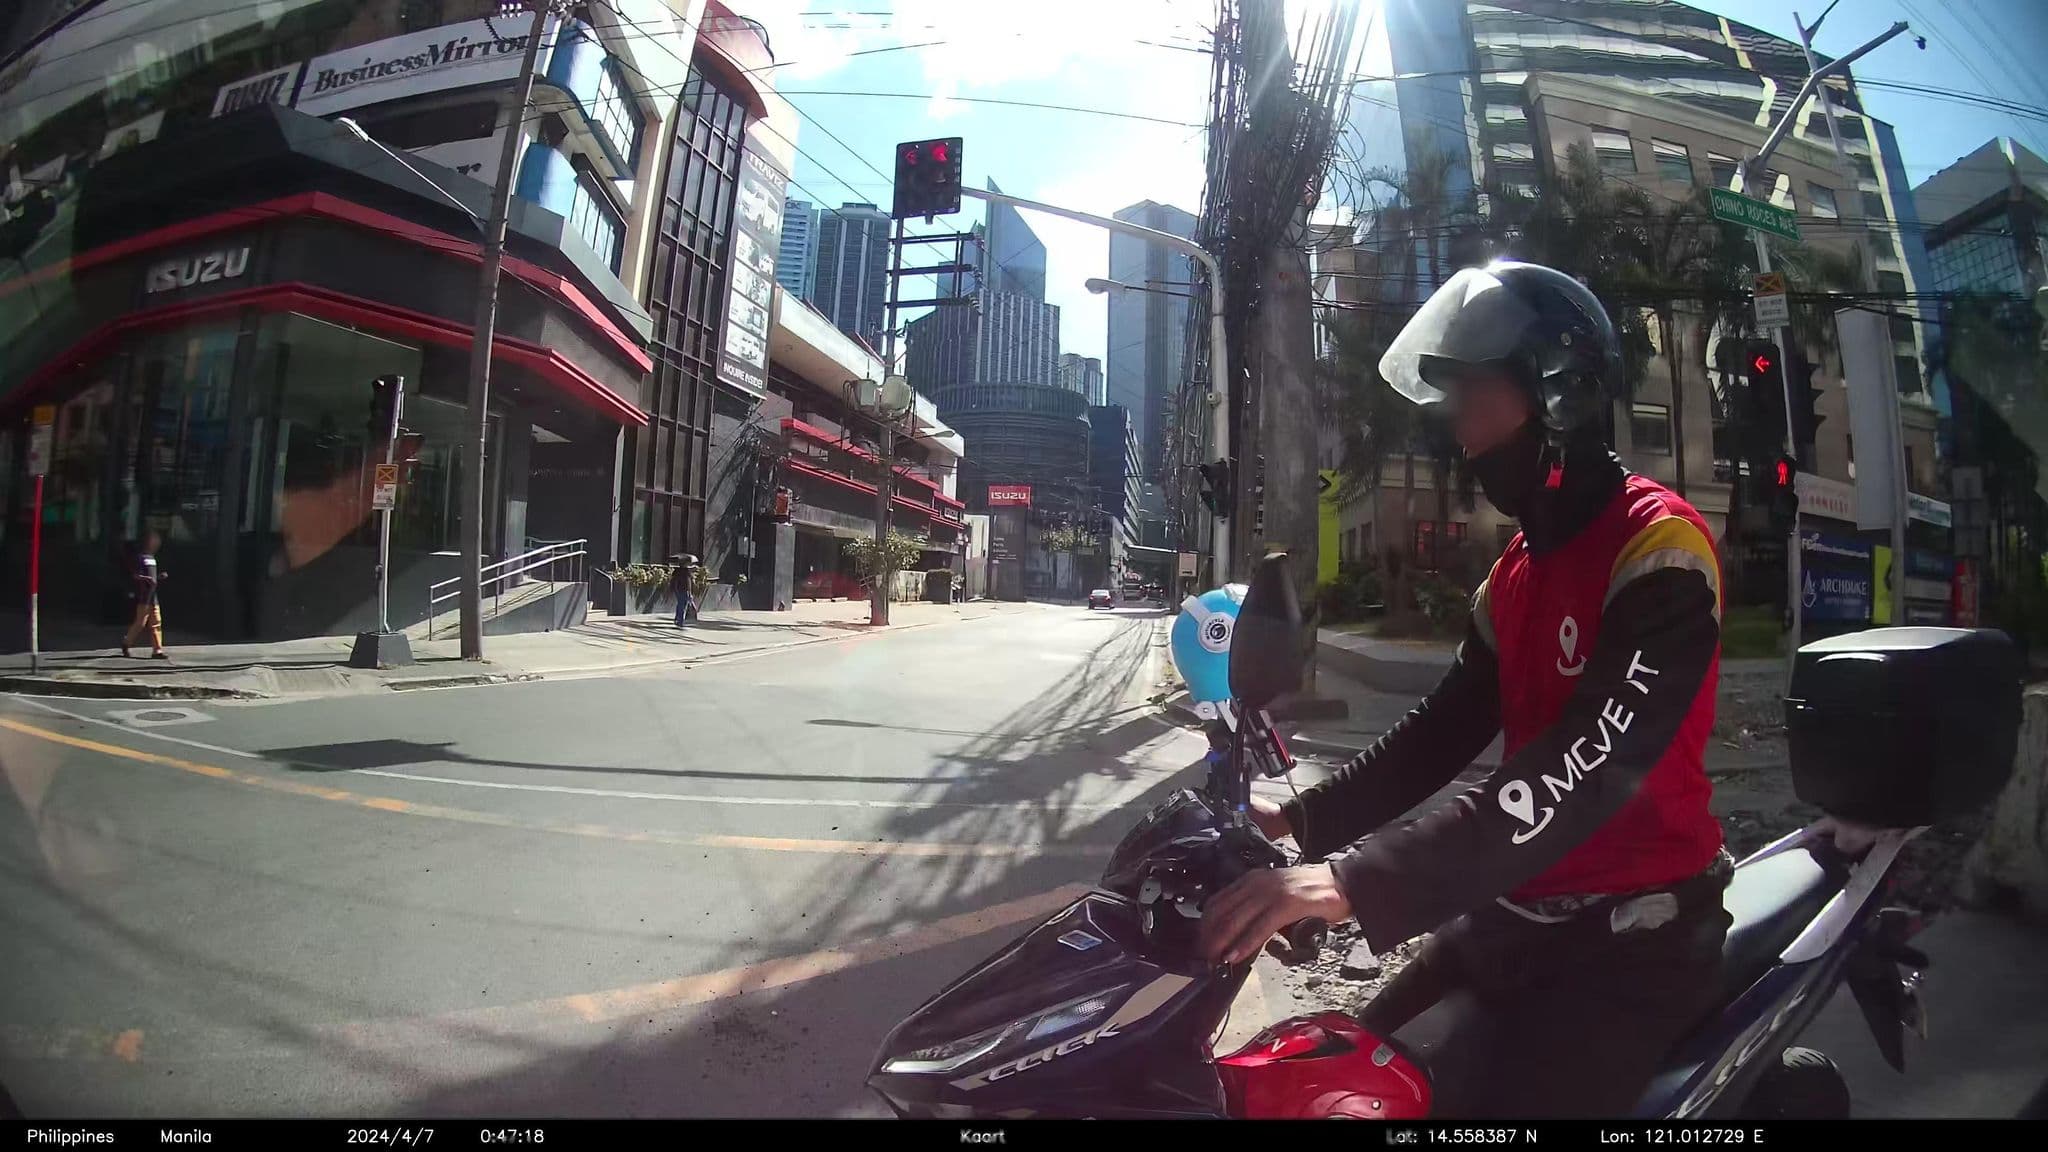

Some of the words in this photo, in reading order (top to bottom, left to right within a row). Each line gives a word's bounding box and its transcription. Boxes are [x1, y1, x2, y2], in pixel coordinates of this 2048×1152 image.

[312, 36, 528, 94] BusinessMirror
[1714, 195, 1745, 216] CHINO
[1746, 204, 1777, 226] ROCES
[145, 247, 250, 293] ISUZU
[991, 491, 1027, 500] ISUZU
[1820, 577, 1867, 597] ARCHDUKE
[1623, 649, 1660, 695] IT
[987, 1021, 1122, 1082] CLICK
